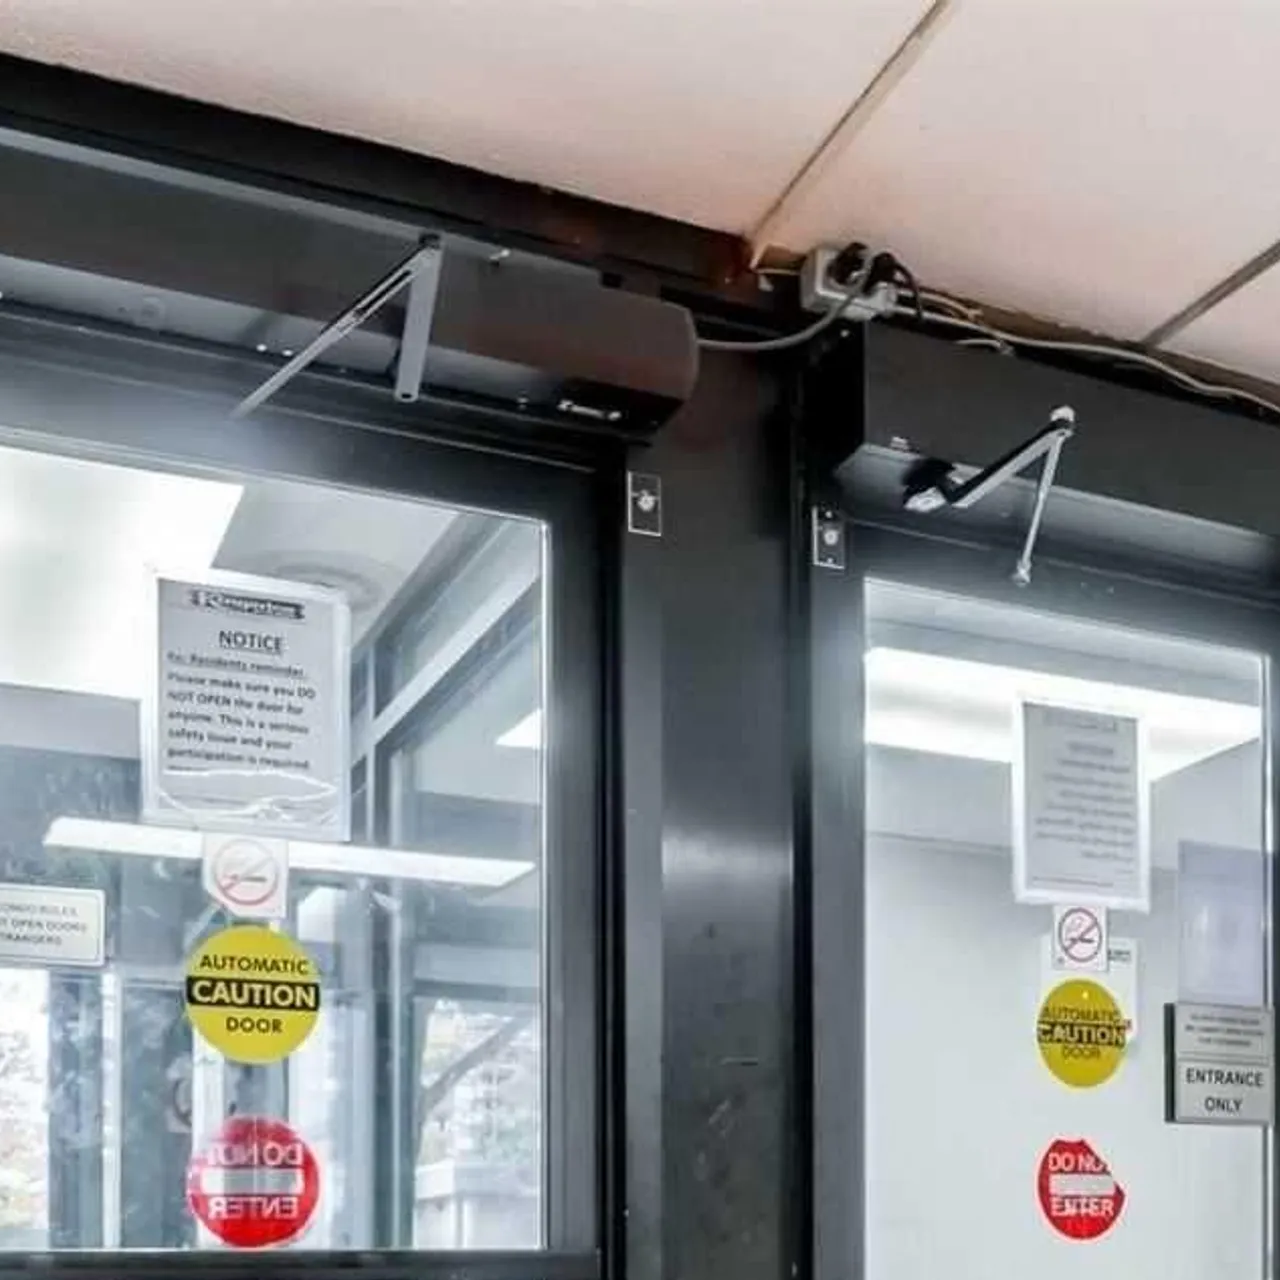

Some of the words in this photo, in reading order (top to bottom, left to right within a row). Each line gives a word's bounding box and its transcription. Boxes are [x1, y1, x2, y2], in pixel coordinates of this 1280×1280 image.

[219, 629, 284, 655] NOTICE
[167, 691, 194, 702] NOT
[196, 693, 232, 706] OPEN
[209, 678, 241, 689] make
[245, 684, 270, 692] sure
[273, 687, 295, 697] you
[296, 686, 317, 699] DO
[219, 713, 243, 726] This
[240, 736, 263, 748] and
[199, 954, 310, 975] AUTOMATIC
[192, 979, 317, 1008] CAUTION
[225, 1015, 283, 1034] DOOR
[1038, 1021, 1126, 1048] CAUTION
[1185, 1066, 1265, 1088] ENTRANCE
[1204, 1095, 1244, 1113] ONLY
[1048, 1152, 1076, 1172] DO
[1050, 1196, 1115, 1219] ENTER
